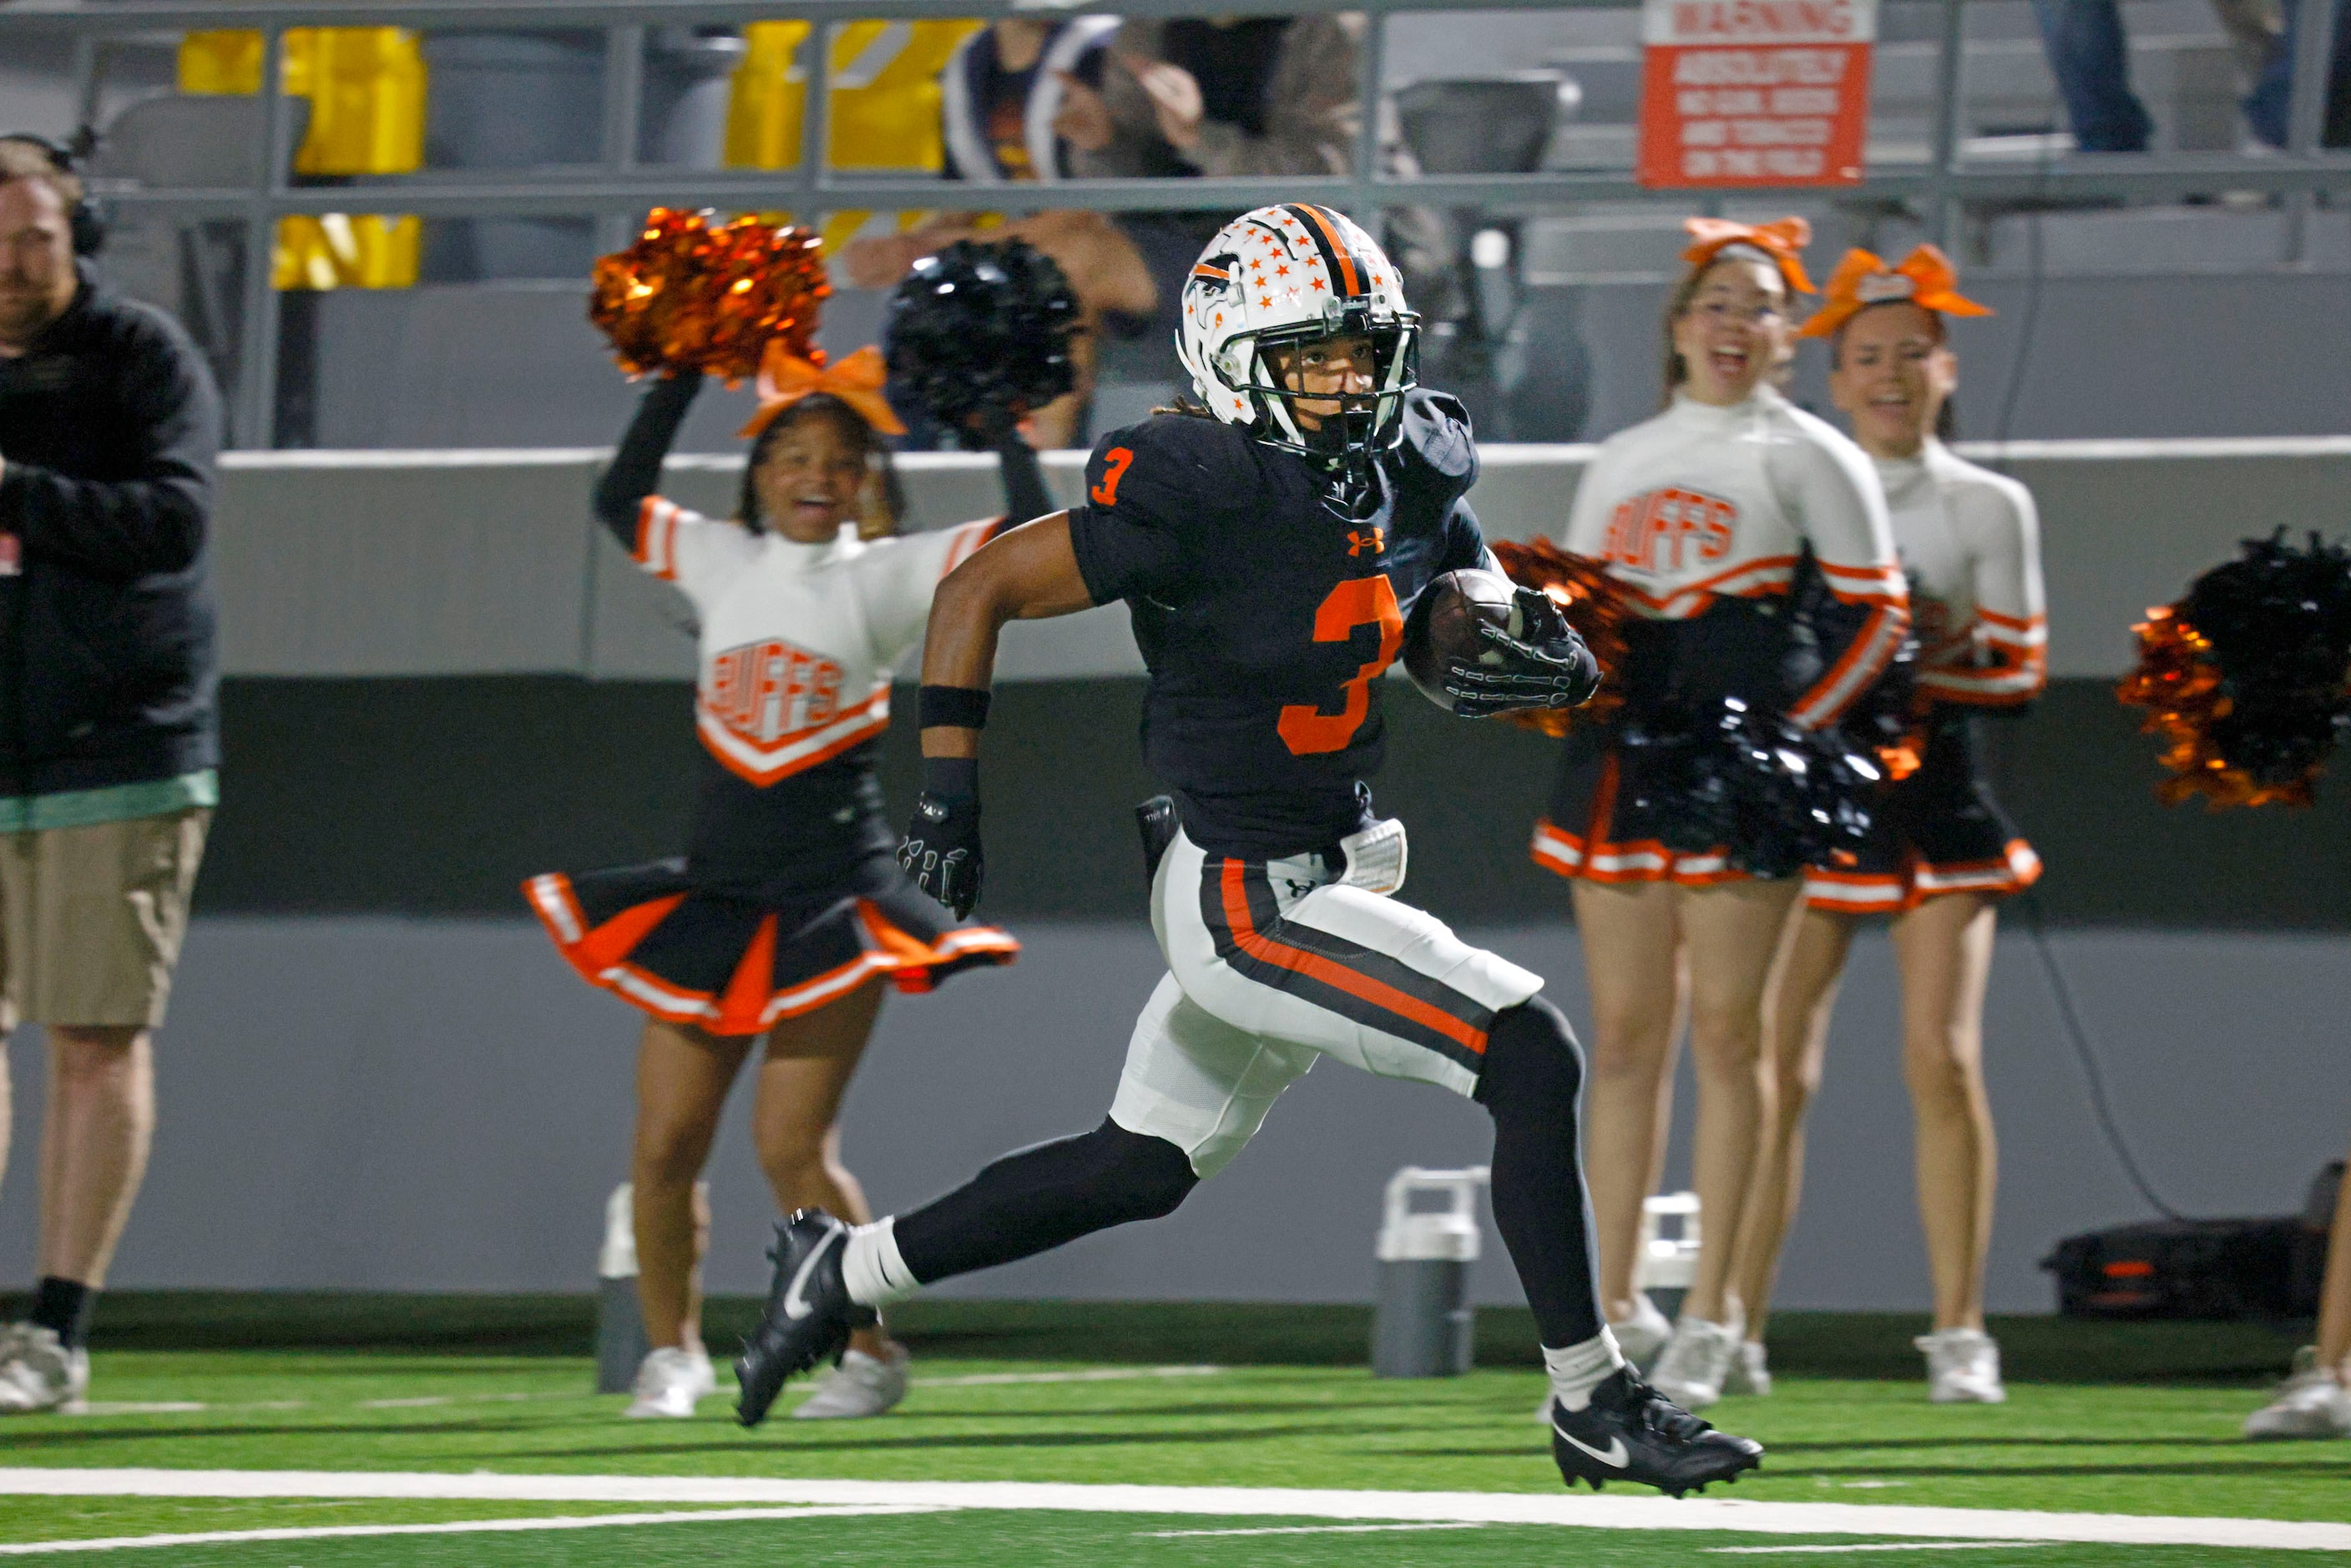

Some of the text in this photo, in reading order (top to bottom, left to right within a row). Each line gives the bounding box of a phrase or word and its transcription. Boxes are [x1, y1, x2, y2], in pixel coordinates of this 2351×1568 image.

[1673, 0, 1852, 34] WARNING
[1673, 48, 1848, 83] ABSOLUTELY
[1091, 447, 1134, 507] 3
[1601, 487, 1737, 571] BUFFS
[710, 641, 842, 736] BUFFS
[1277, 574, 1403, 756] 3
